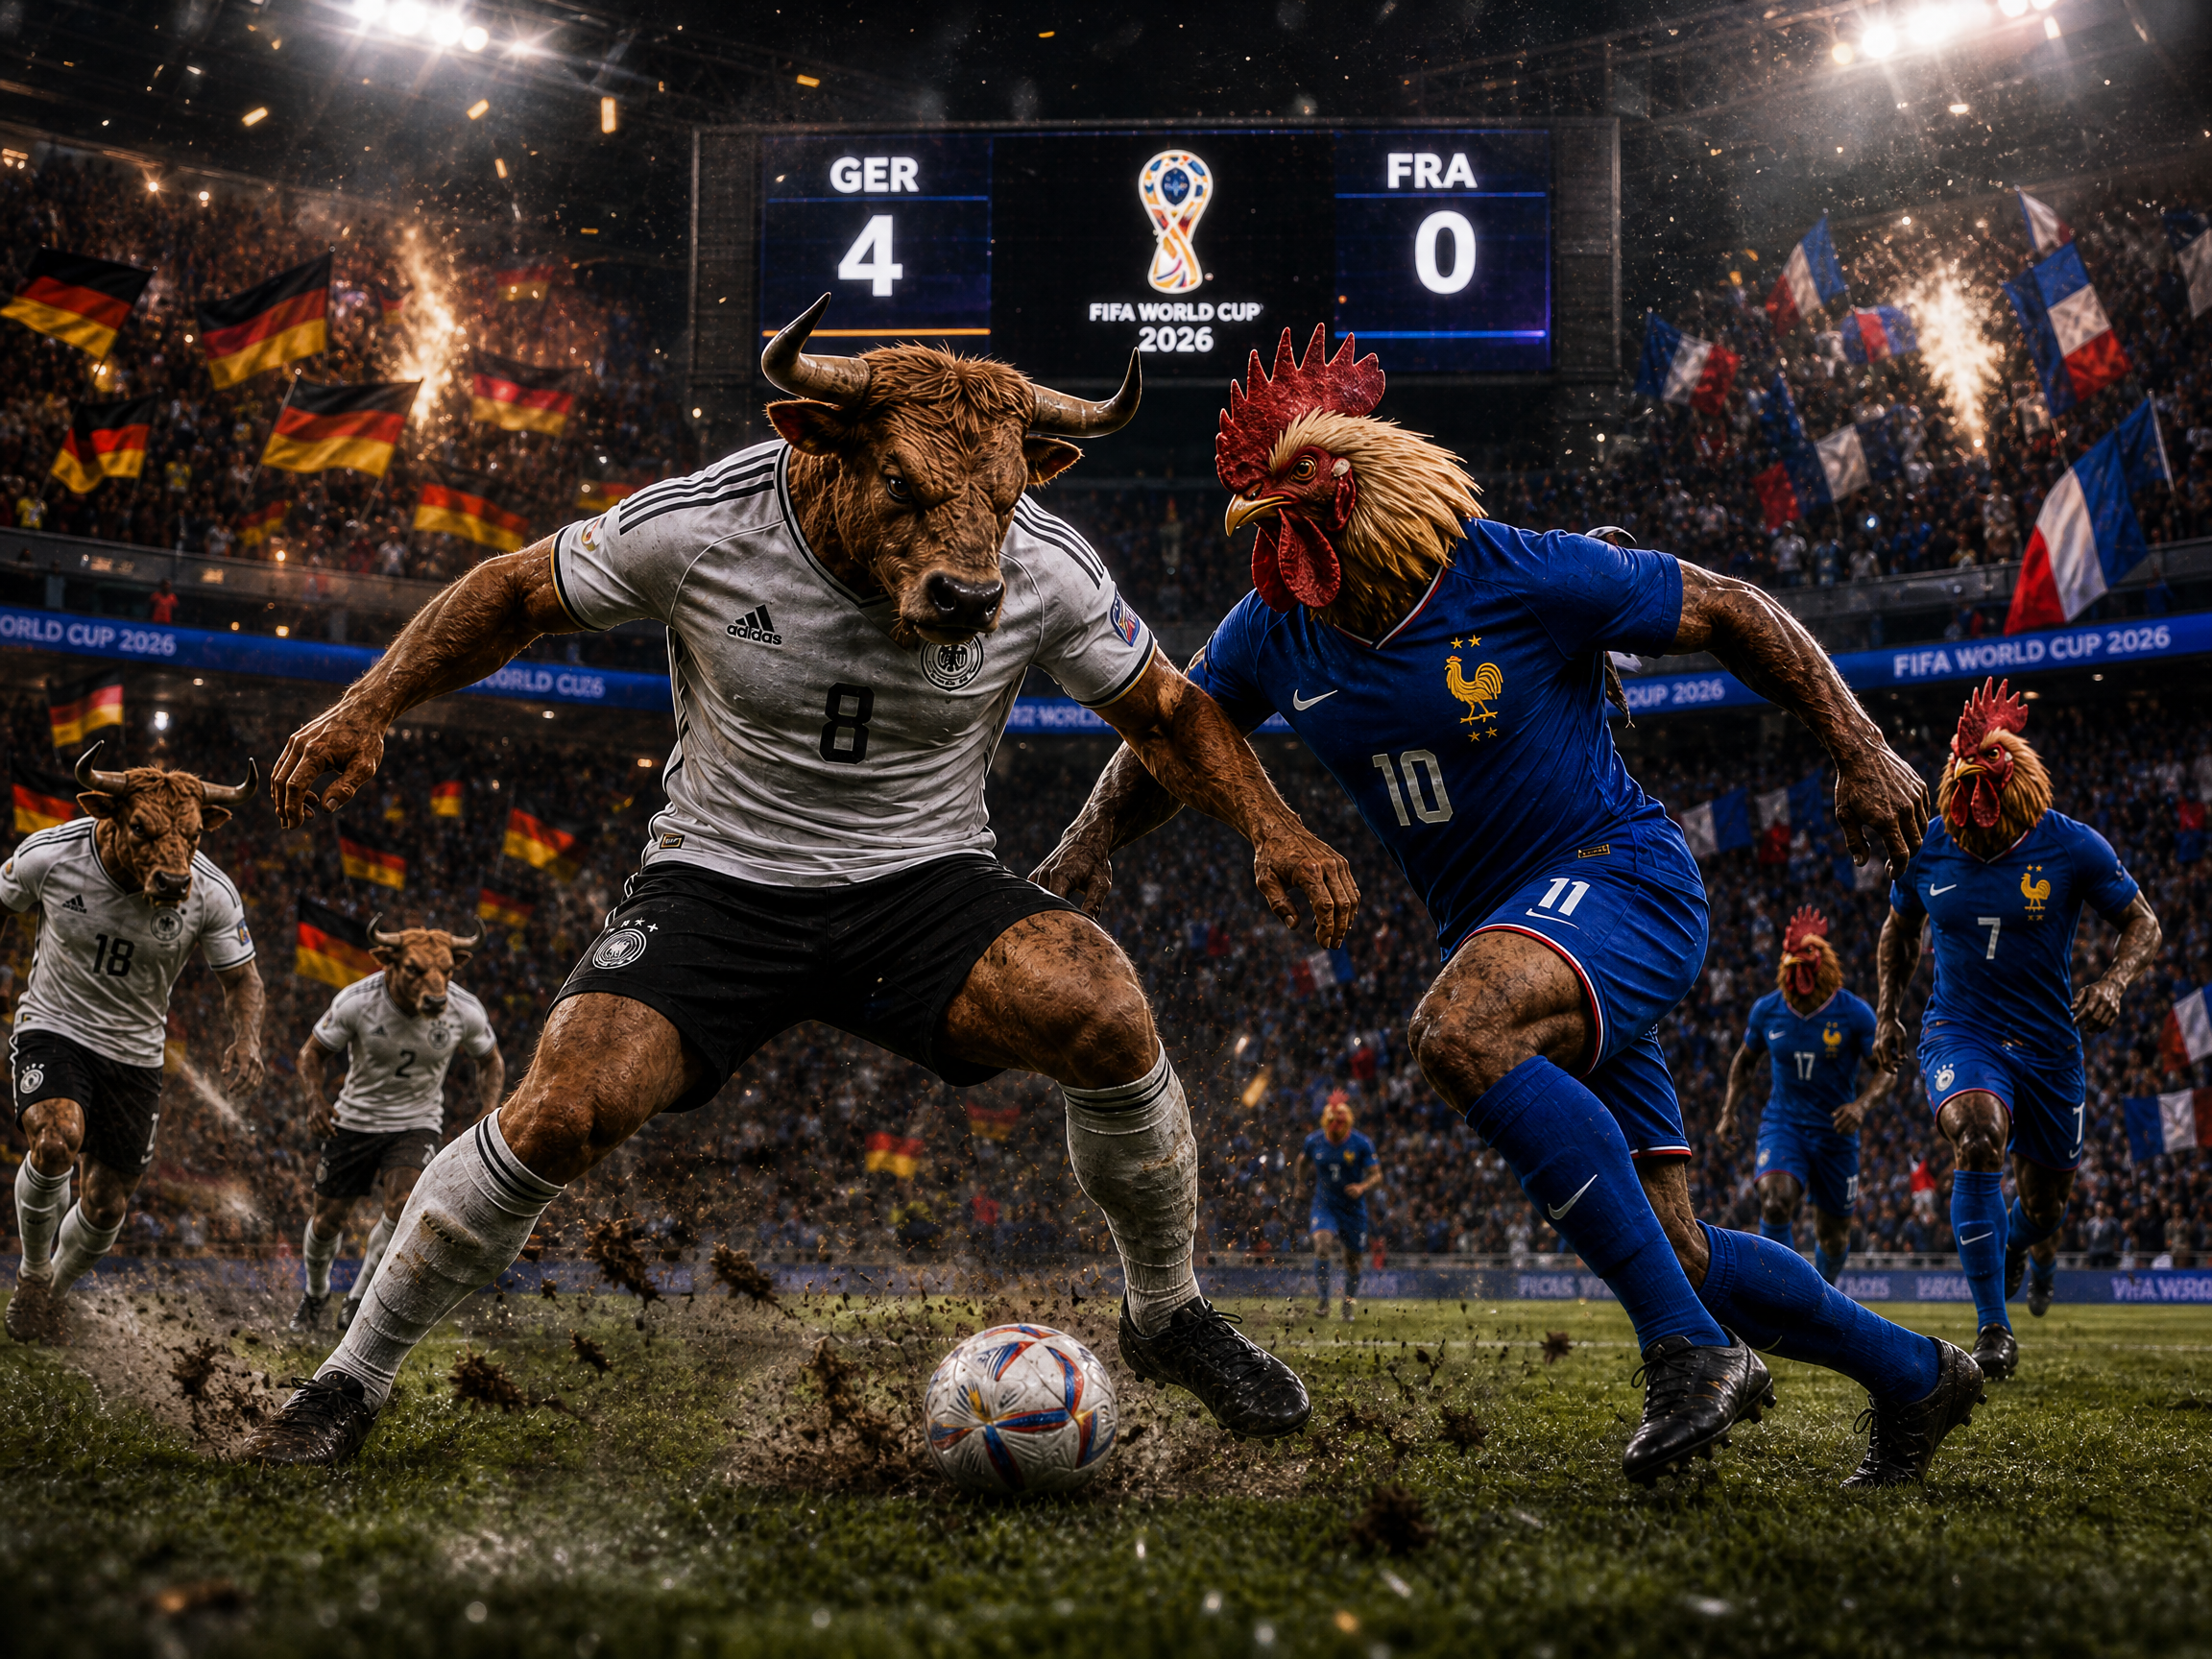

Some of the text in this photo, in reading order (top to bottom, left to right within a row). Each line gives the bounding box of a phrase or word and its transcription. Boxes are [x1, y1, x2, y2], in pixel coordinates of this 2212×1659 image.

[830, 156, 920, 194] GER
[1387, 152, 1479, 189] FRA
[837, 214, 903, 298] 4
[1414, 209, 1477, 295] 0
[1089, 302, 1261, 322] FIFA WORLD CUP
[1138, 325, 1214, 352] 2026
[66, 622, 116, 649] CUP
[118, 628, 178, 658] 2026
[726, 624, 782, 646] adidas
[1893, 625, 2172, 678] FIFA WORLD CUP 2026
[1625, 678, 1726, 709] CUP 2026
[818, 681, 875, 765] 8
[1372, 749, 1454, 827] 10
[1538, 878, 1590, 917] 11
[92, 933, 135, 977] 18
[1977, 917, 2002, 960] 7
[395, 1048, 417, 1079] 2
[1793, 1050, 1816, 1081] 17
